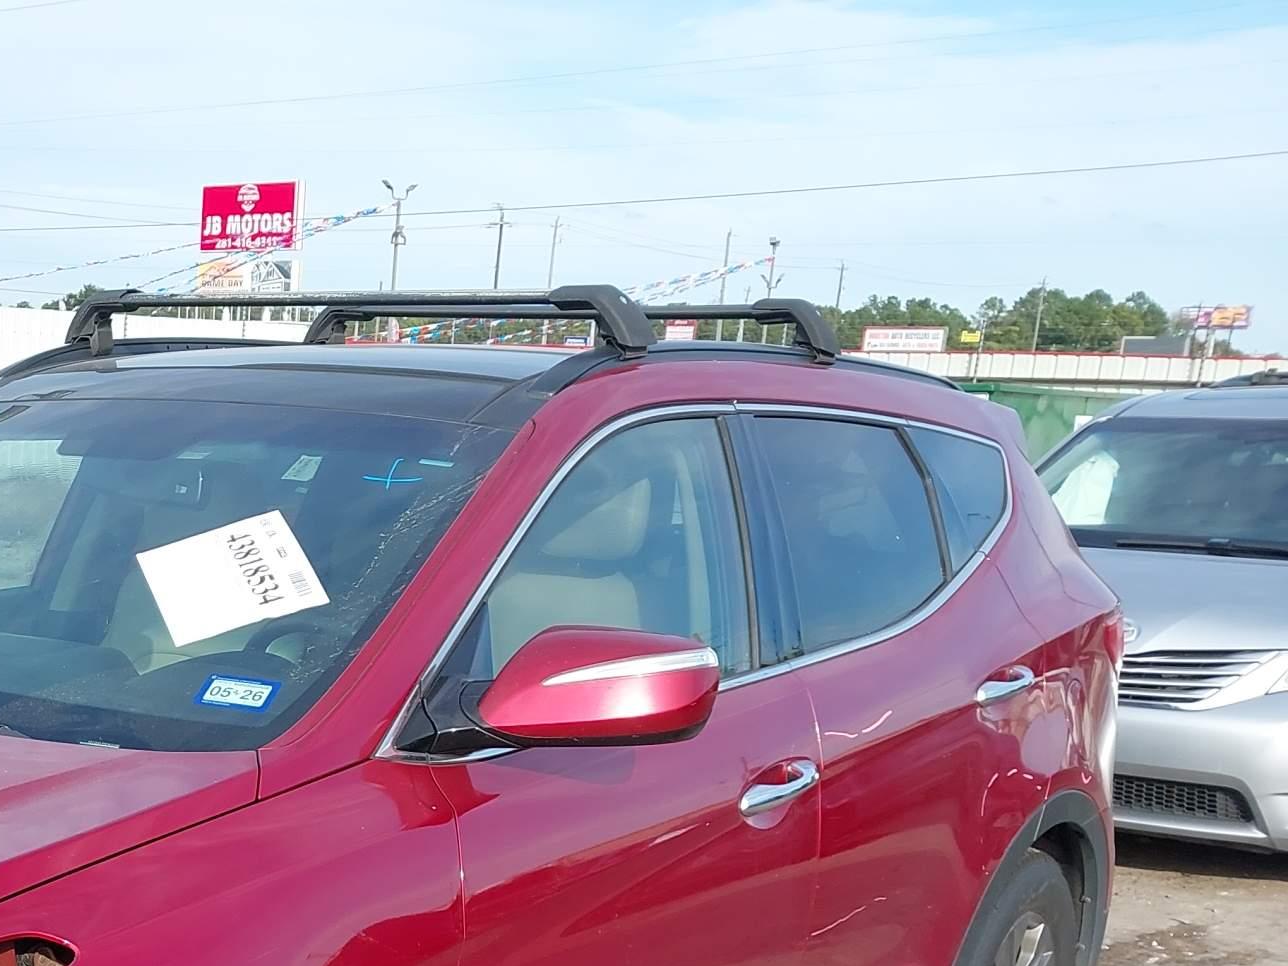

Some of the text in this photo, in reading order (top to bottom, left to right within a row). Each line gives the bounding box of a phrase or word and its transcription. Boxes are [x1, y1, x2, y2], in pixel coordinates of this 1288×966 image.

[203, 212, 292, 236] JB MOTORS
[227, 534, 285, 605] 43818534
